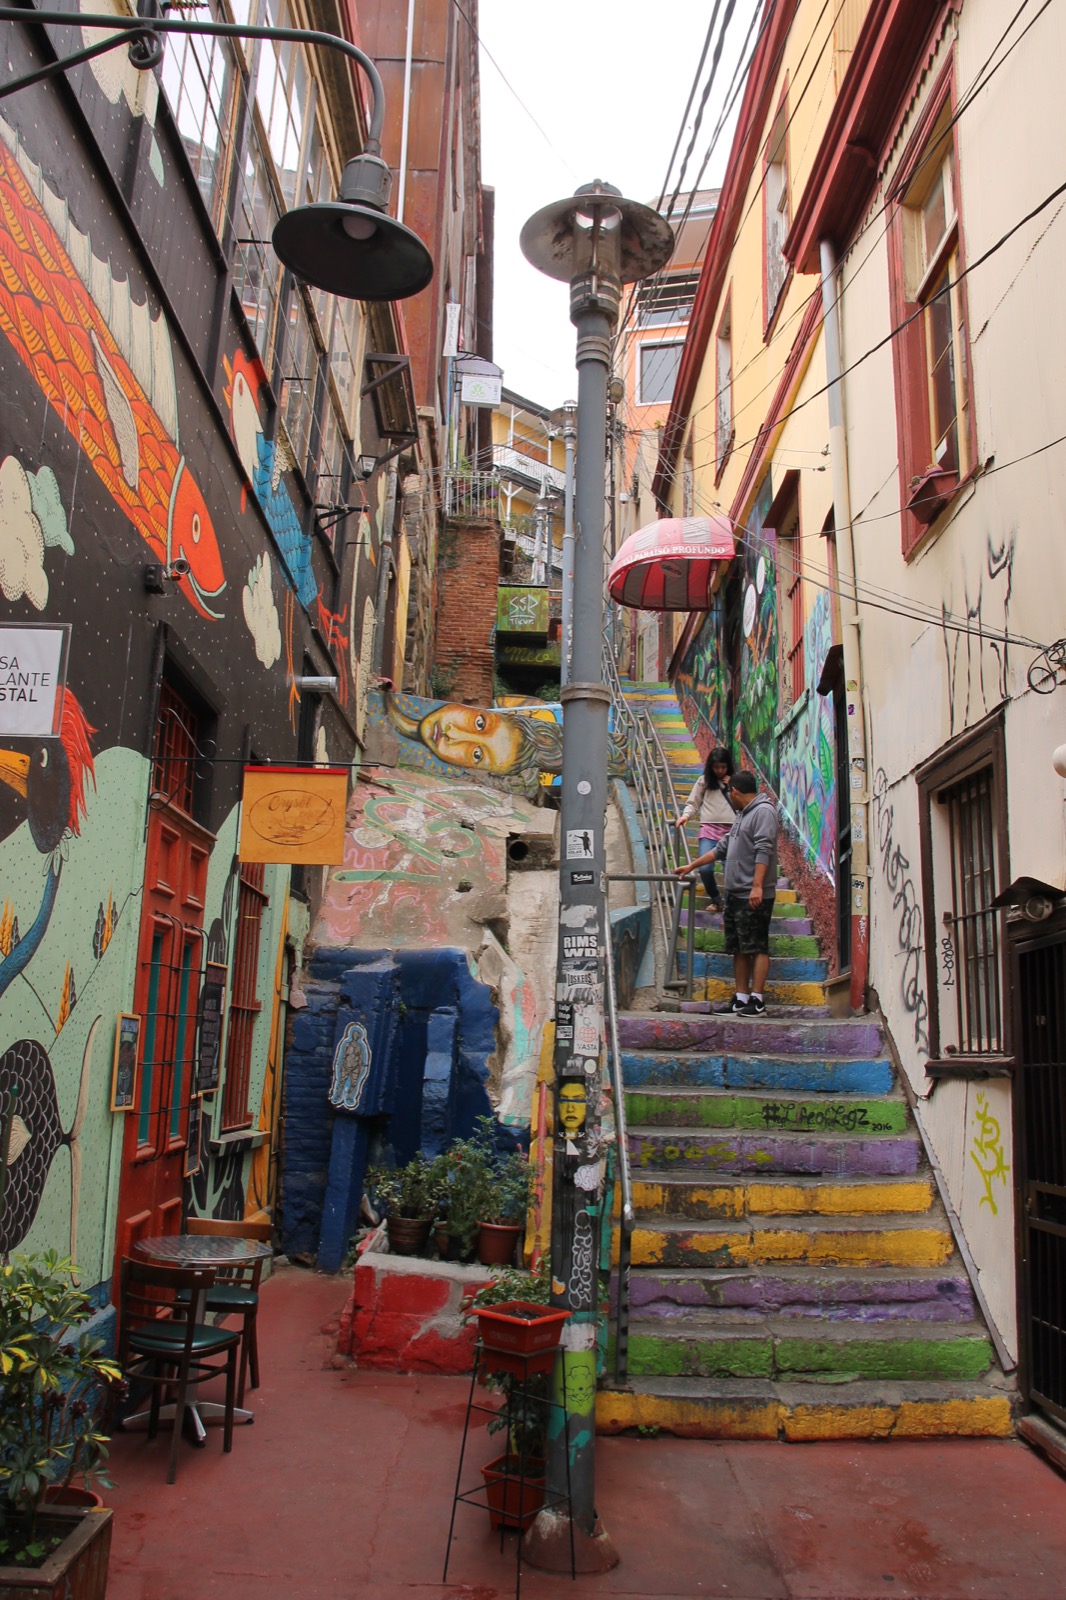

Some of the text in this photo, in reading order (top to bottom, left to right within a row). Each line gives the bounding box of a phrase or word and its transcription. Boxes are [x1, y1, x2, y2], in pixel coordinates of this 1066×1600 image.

[447, 306, 457, 346] HOSTAL
[672, 546, 725, 554] PROFUNDO
[0, 656, 19, 670] SA
[0, 688, 38, 702] STAL
[563, 936, 597, 948] RIMS
[564, 948, 597, 957] WD
[872, 1123, 892, 1131] 2016
